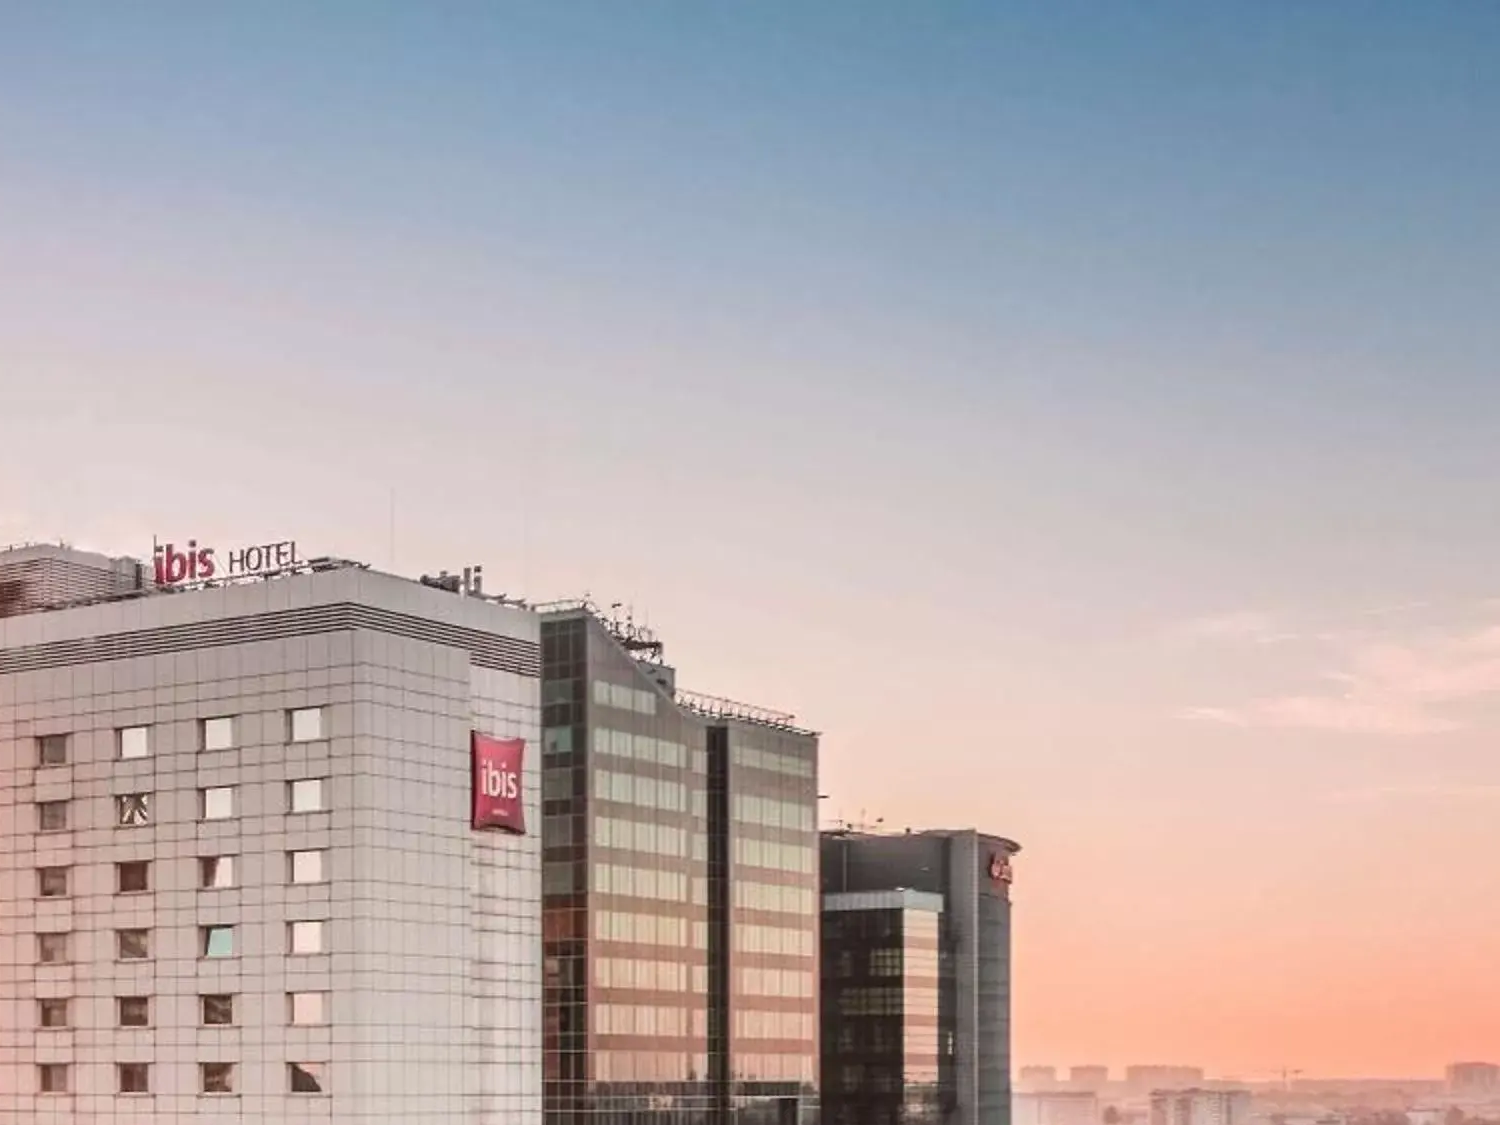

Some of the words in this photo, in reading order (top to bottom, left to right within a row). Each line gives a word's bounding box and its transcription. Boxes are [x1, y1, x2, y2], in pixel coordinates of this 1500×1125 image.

[154, 539, 215, 585] ibis
[229, 541, 301, 573] HOTEL
[480, 759, 517, 799] ibis
